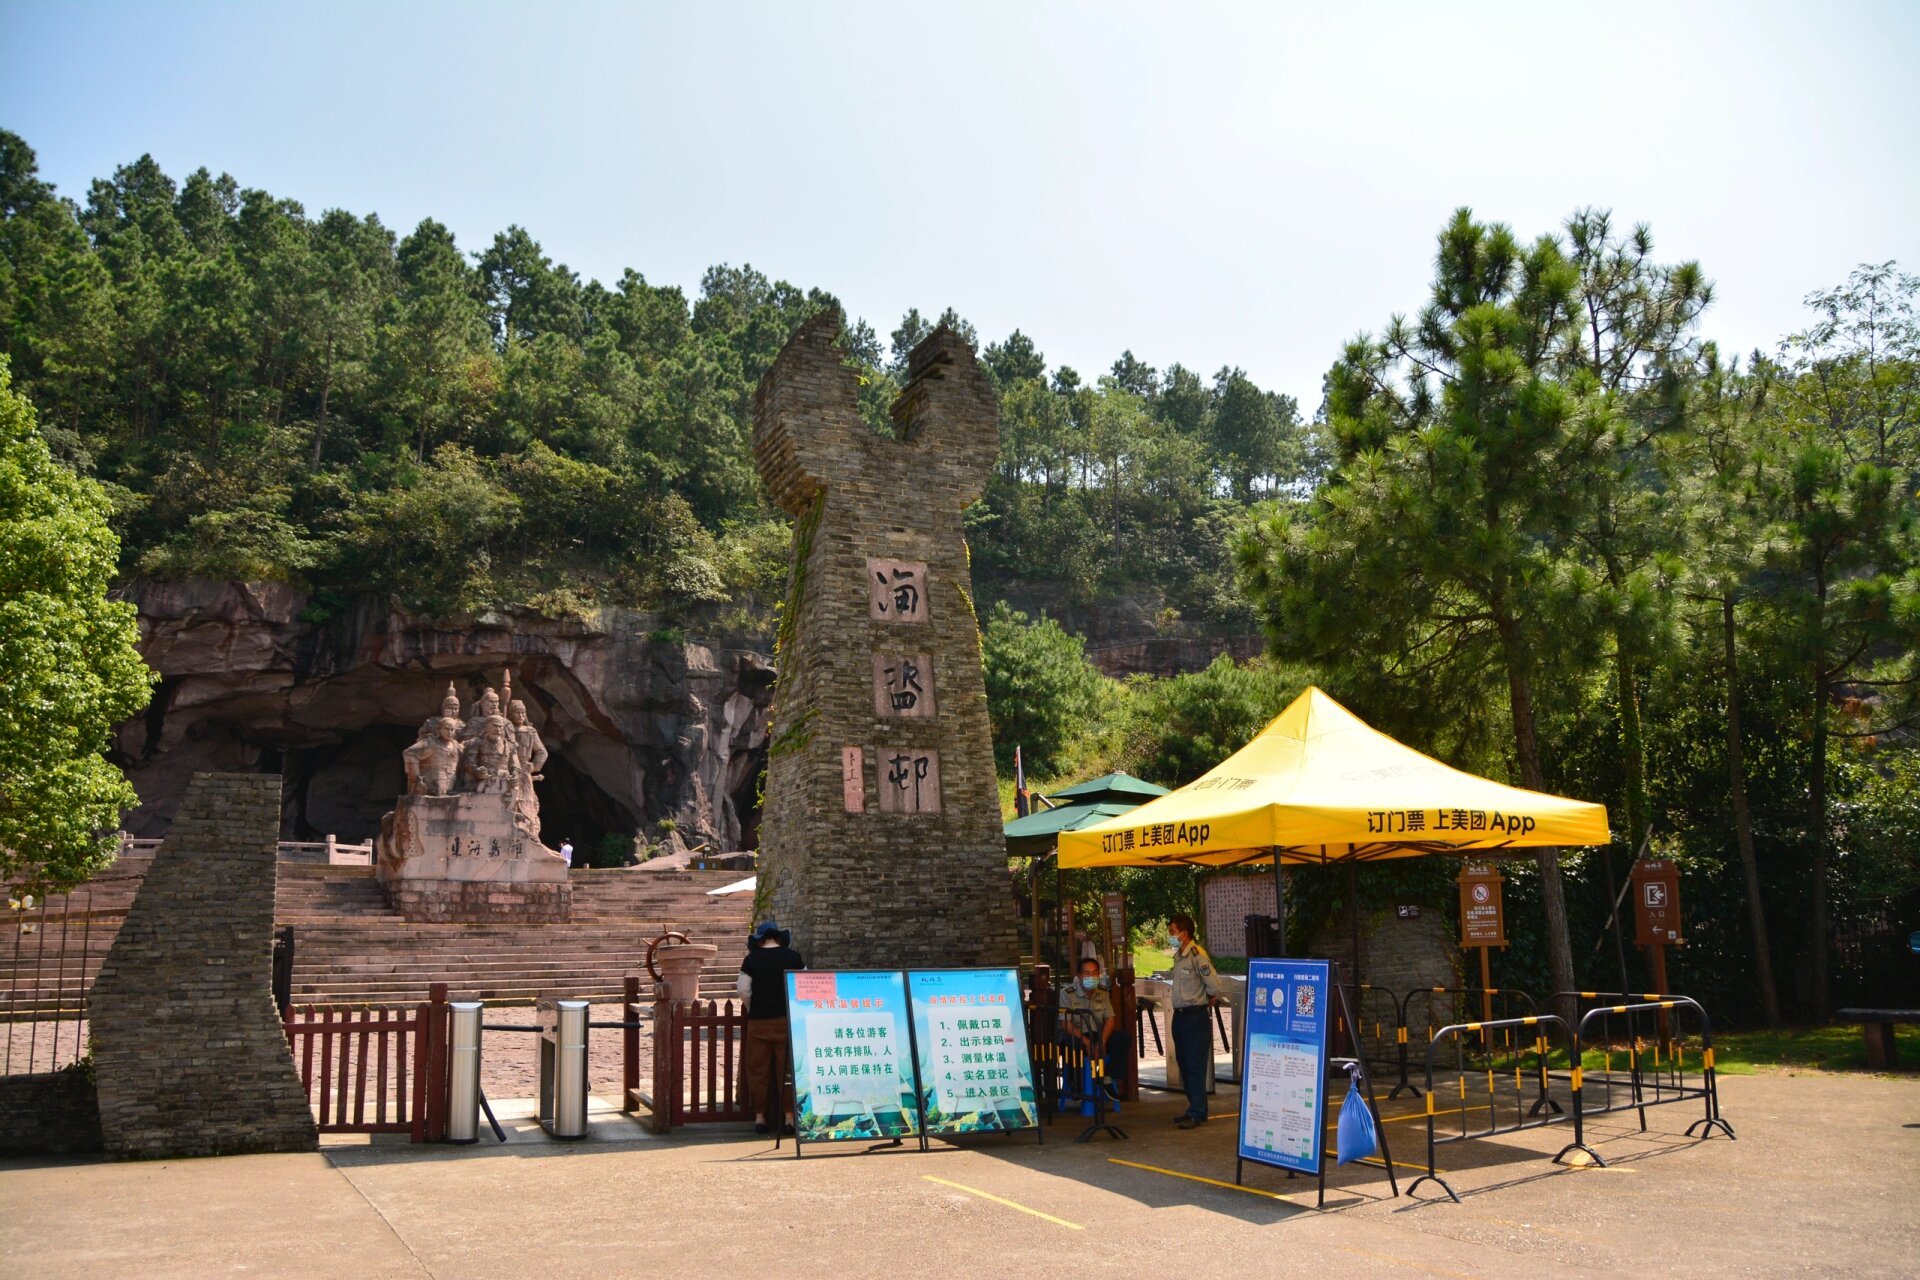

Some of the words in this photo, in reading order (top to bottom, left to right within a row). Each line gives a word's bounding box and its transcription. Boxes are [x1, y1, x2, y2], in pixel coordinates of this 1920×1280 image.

[1368, 810, 1425, 833] 订门票
[1433, 809, 1536, 835] 上美团App
[1102, 829, 1135, 853] 订门票
[1140, 822, 1210, 847] 上美团App
[814, 998, 884, 1009] 疫情温馨提示
[929, 994, 1006, 1005] 疫情防控工作流程
[940, 1018, 1002, 1031] 1、佩戴口罩
[834, 1027, 887, 1039] 请各位游客
[941, 1035, 1004, 1048] 2、出示绿码
[943, 1052, 1007, 1064] 3、测量体温
[815, 1064, 894, 1077] 与人间距保持在
[945, 1069, 1009, 1082] 4、实名登记
[947, 1085, 1011, 1098] 5、进入景区
